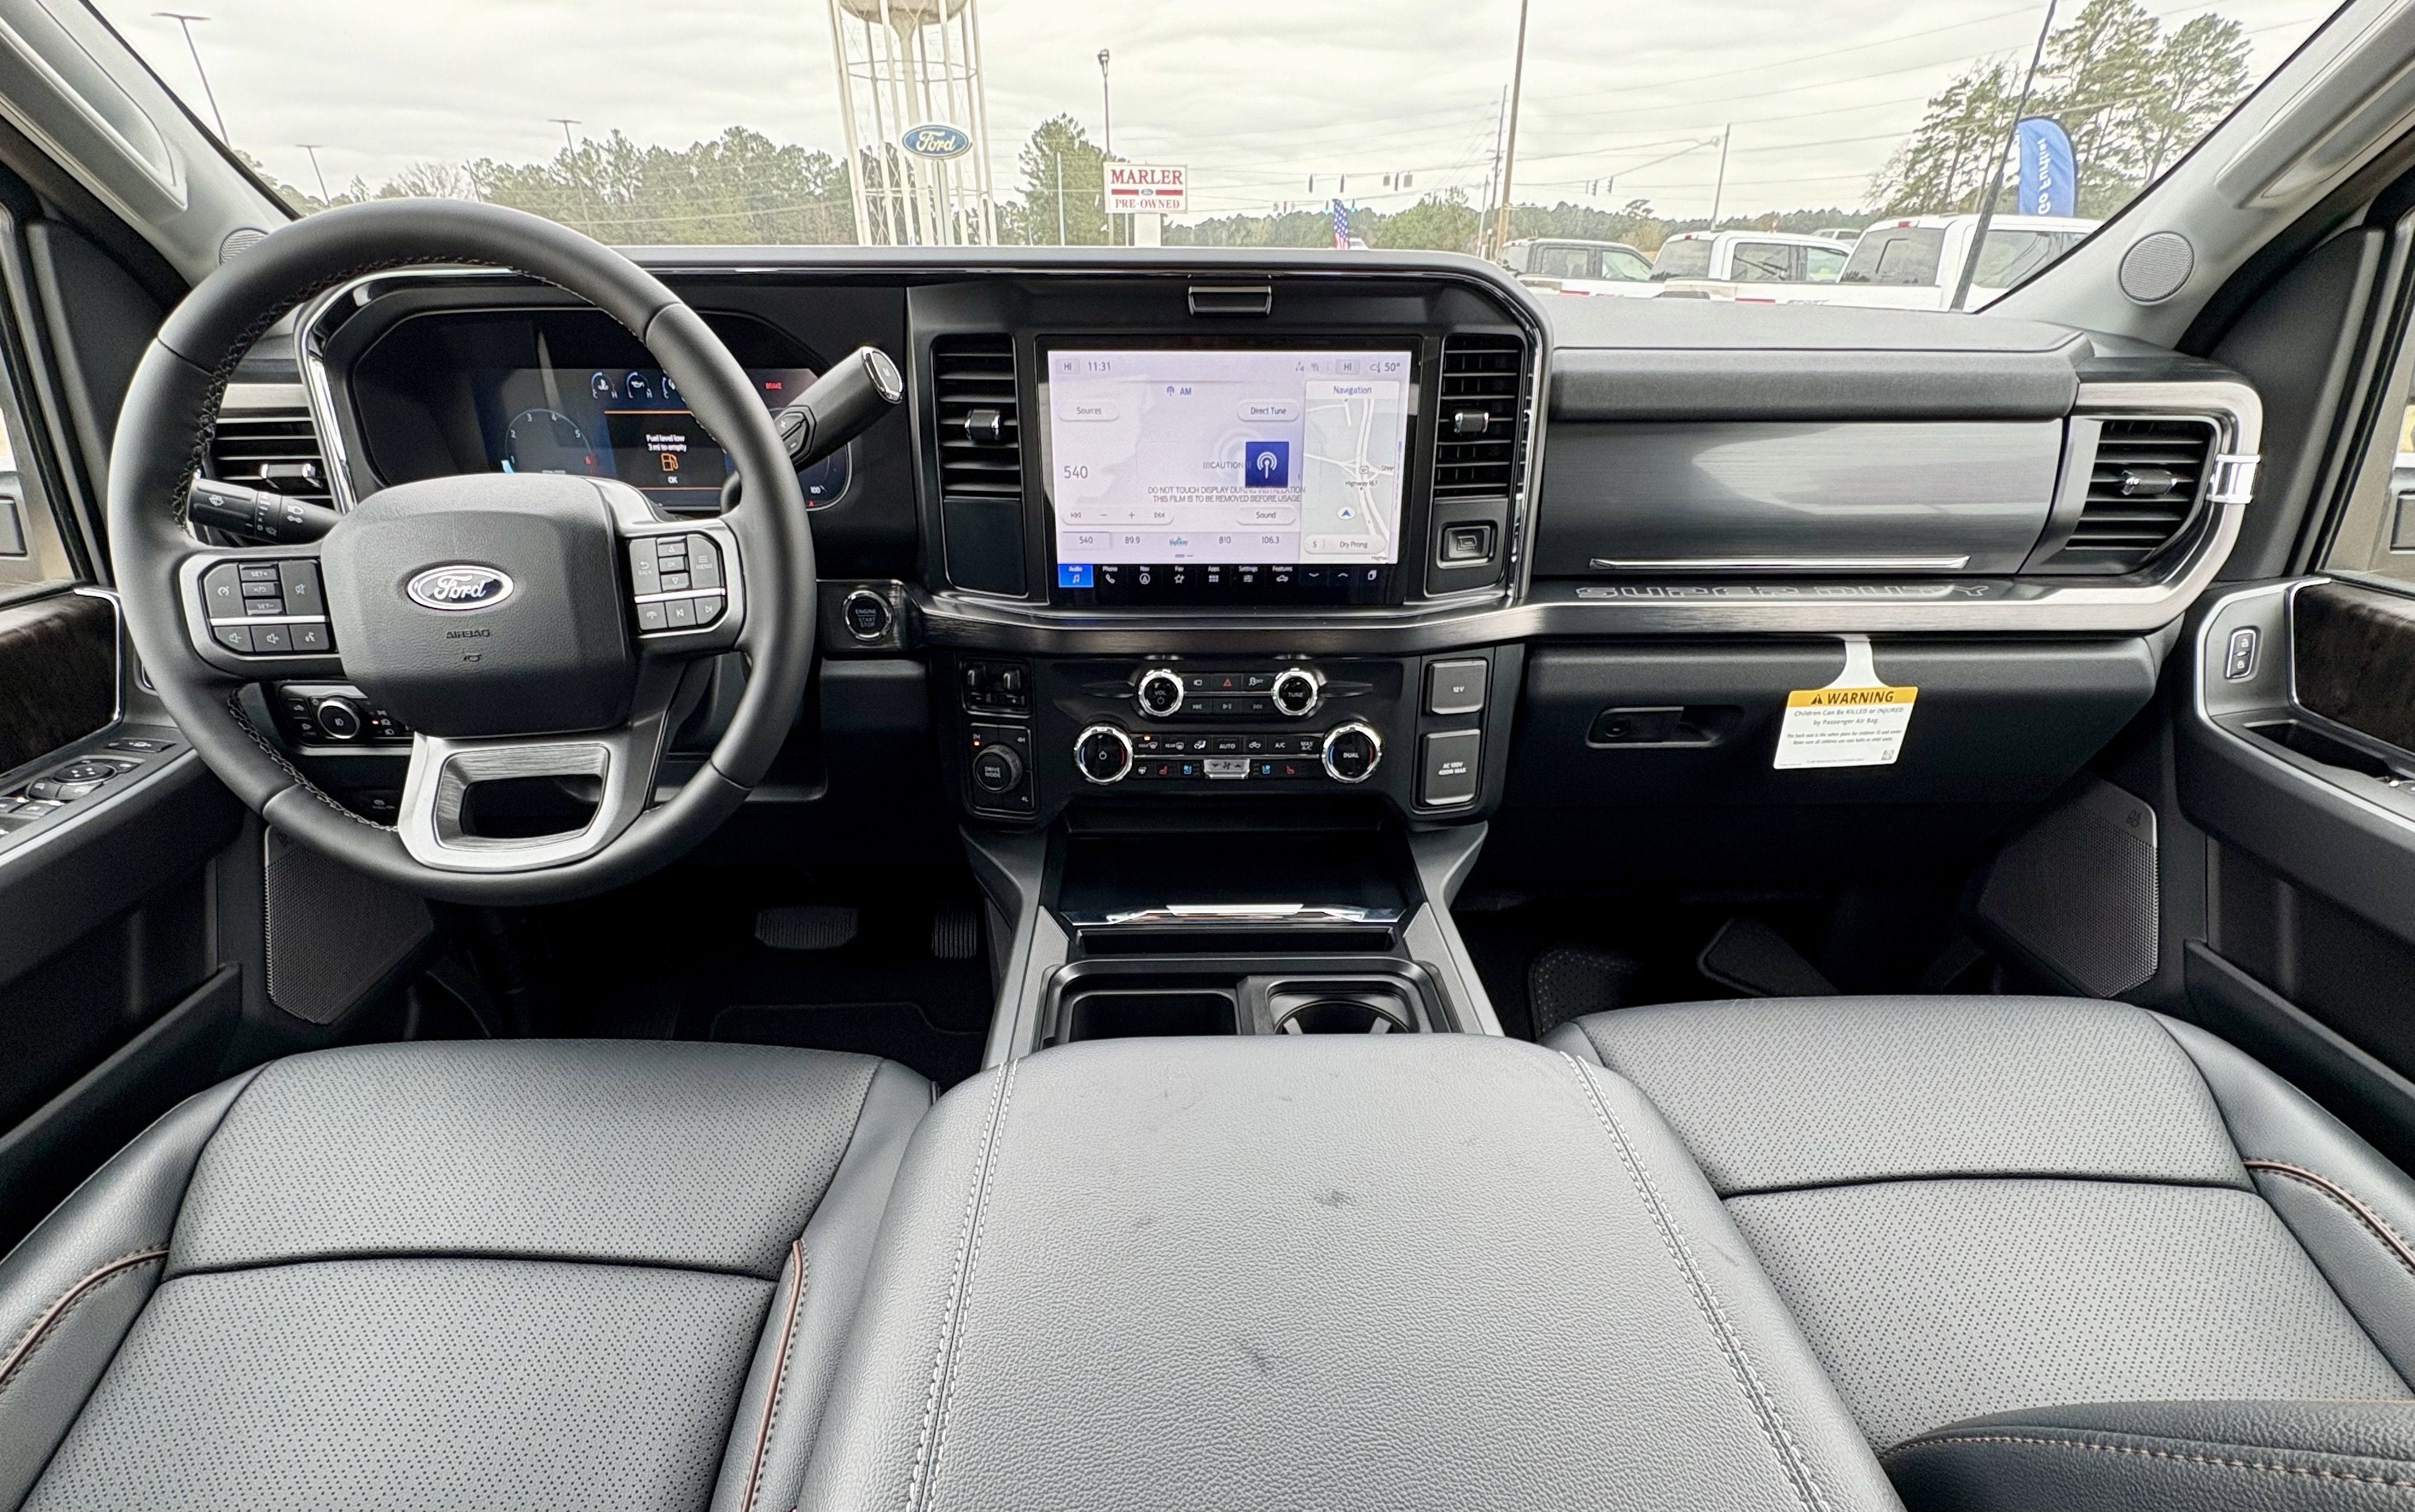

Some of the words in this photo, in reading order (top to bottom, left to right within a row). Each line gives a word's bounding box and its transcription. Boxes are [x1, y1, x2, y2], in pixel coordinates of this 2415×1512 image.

[916, 130, 956, 152] Ford
[1111, 169, 1183, 185] MARLER
[1115, 199, 1180, 209] PRE-OWNED
[1064, 362, 1072, 371] HI
[1087, 362, 1111, 371] 11:31
[1180, 387, 1192, 395] AM
[1333, 386, 1372, 395] Navigation
[1076, 406, 1102, 415] Sources
[526, 413, 533, 422] 3
[510, 430, 516, 438] 2
[575, 429, 581, 438] 5
[1064, 465, 1089, 479] 540
[1079, 536, 1093, 544] 540
[433, 575, 488, 599] Ford
[1576, 586, 1799, 598] SUPER
[1828, 691, 1895, 705] WARNING
